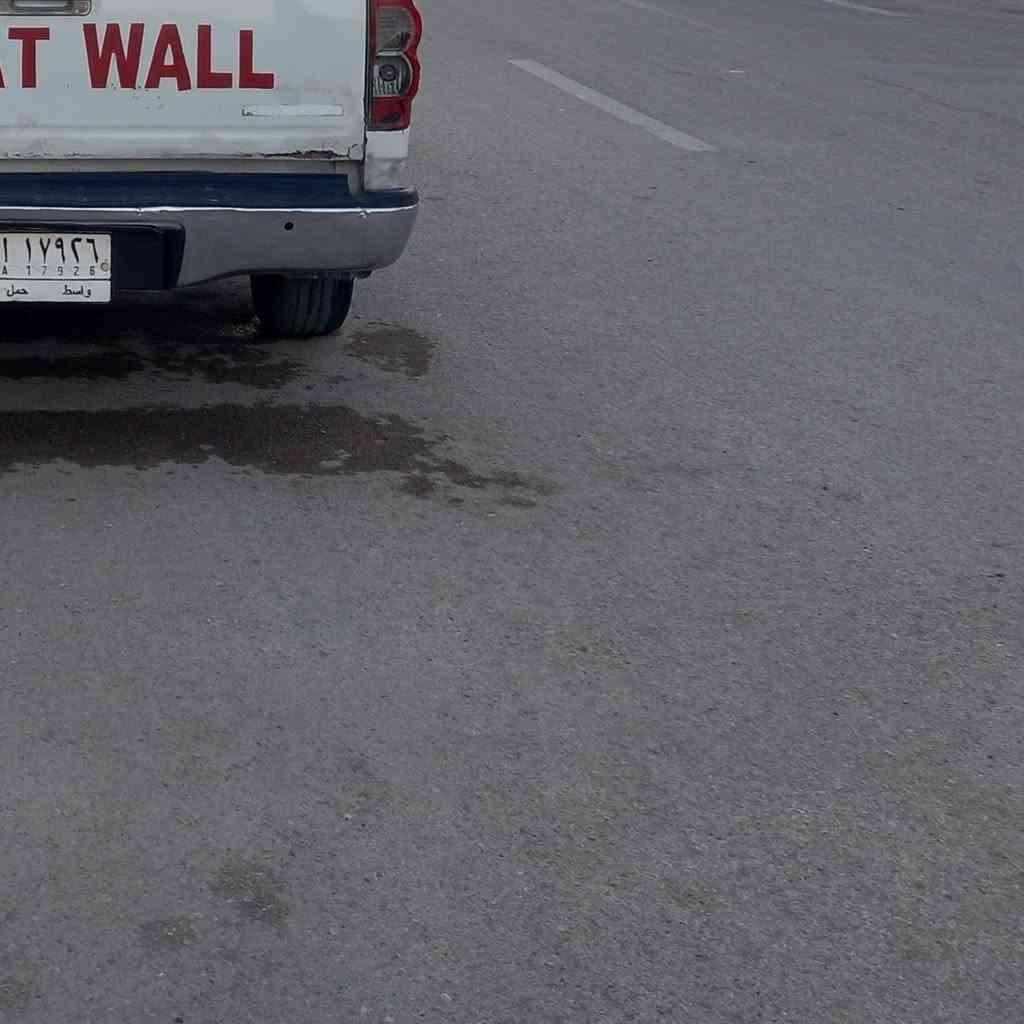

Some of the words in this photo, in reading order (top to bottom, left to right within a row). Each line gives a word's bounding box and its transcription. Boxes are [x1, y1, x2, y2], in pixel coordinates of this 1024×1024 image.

[82, 22, 275, 91] WALL
[6, 284, 29, 297] حمل
[61, 284, 92, 297] واسط
